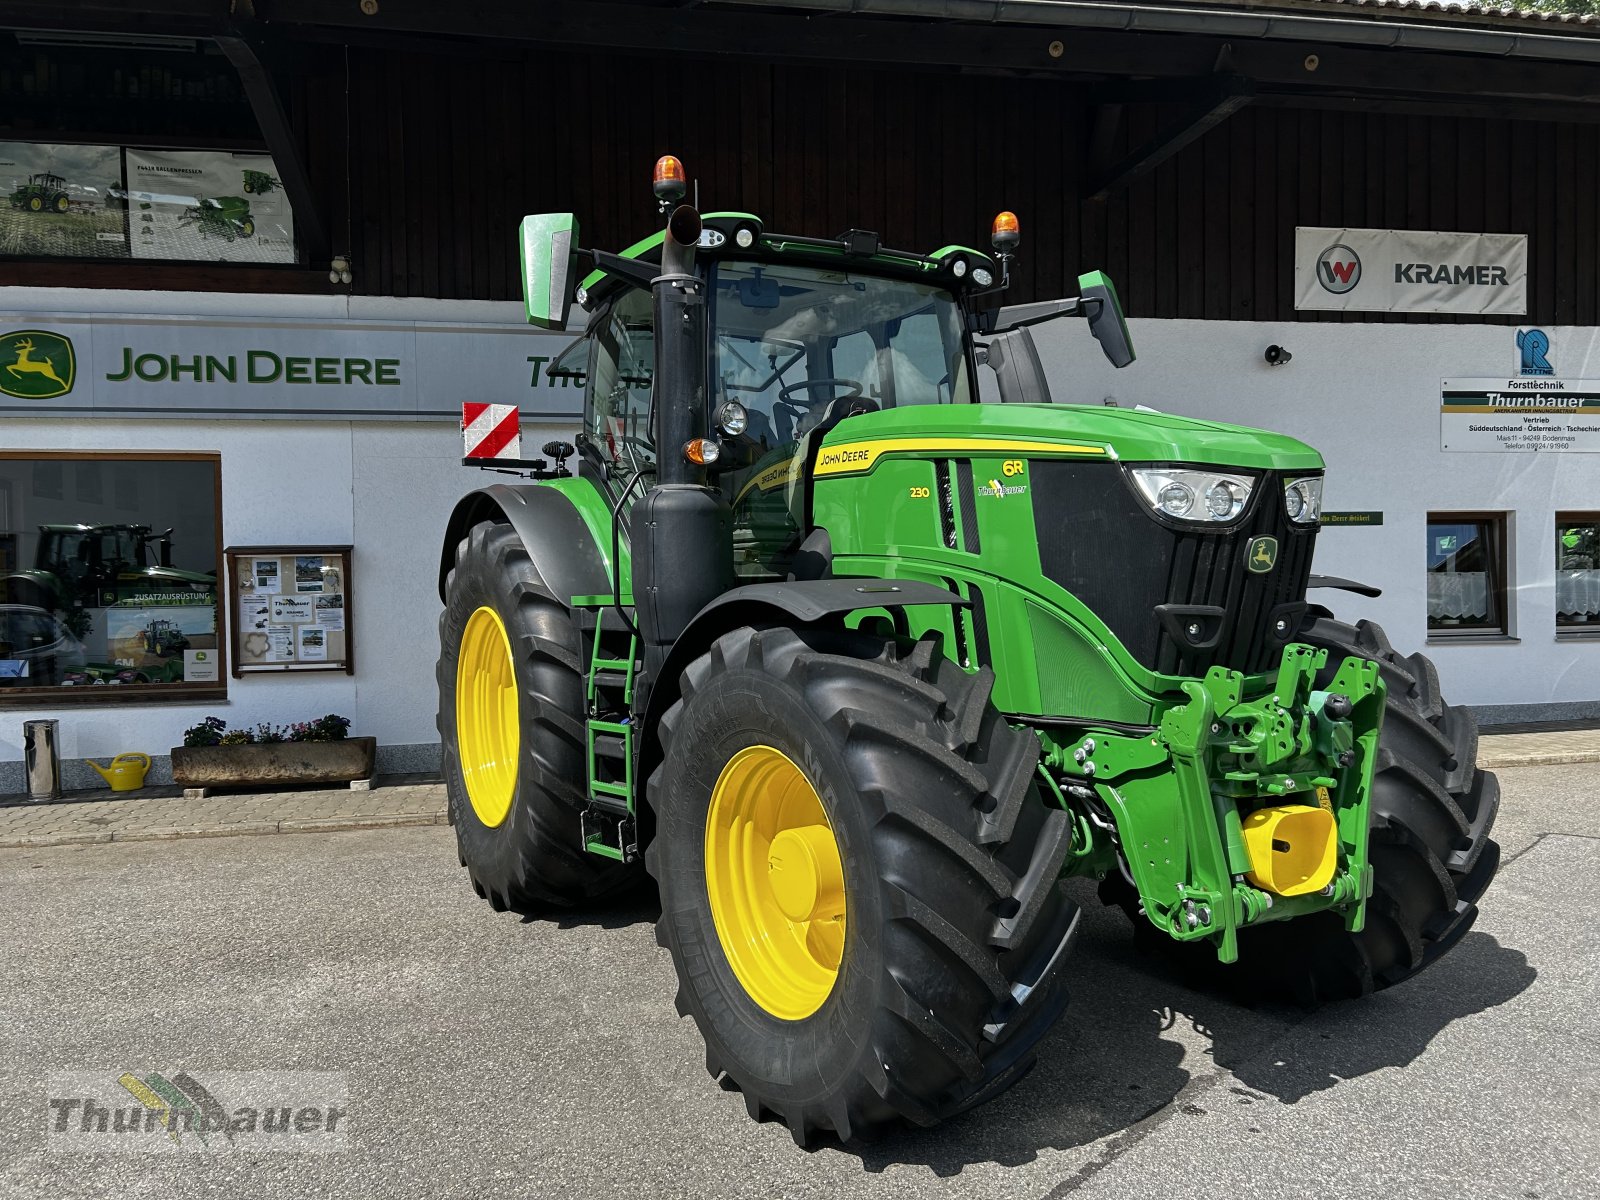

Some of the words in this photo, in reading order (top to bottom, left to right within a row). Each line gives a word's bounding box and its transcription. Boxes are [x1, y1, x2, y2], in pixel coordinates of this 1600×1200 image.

[1394, 263, 1509, 286] KRAMER
[106, 347, 237, 383] JOHN
[247, 349, 401, 386] DEERE
[1508, 380, 1565, 390] Forsttechnik
[1486, 393, 1585, 408] Thurnbauer
[1468, 424, 1523, 433] Süddeutschland
[1527, 424, 1562, 433] Österreich
[820, 453, 842, 466] JOHN
[841, 449, 870, 463] DEERE
[1002, 459, 1024, 477] 6R
[909, 487, 930, 498] 230
[134, 592, 210, 601] ZUSATZAUSRÜSTUNG
